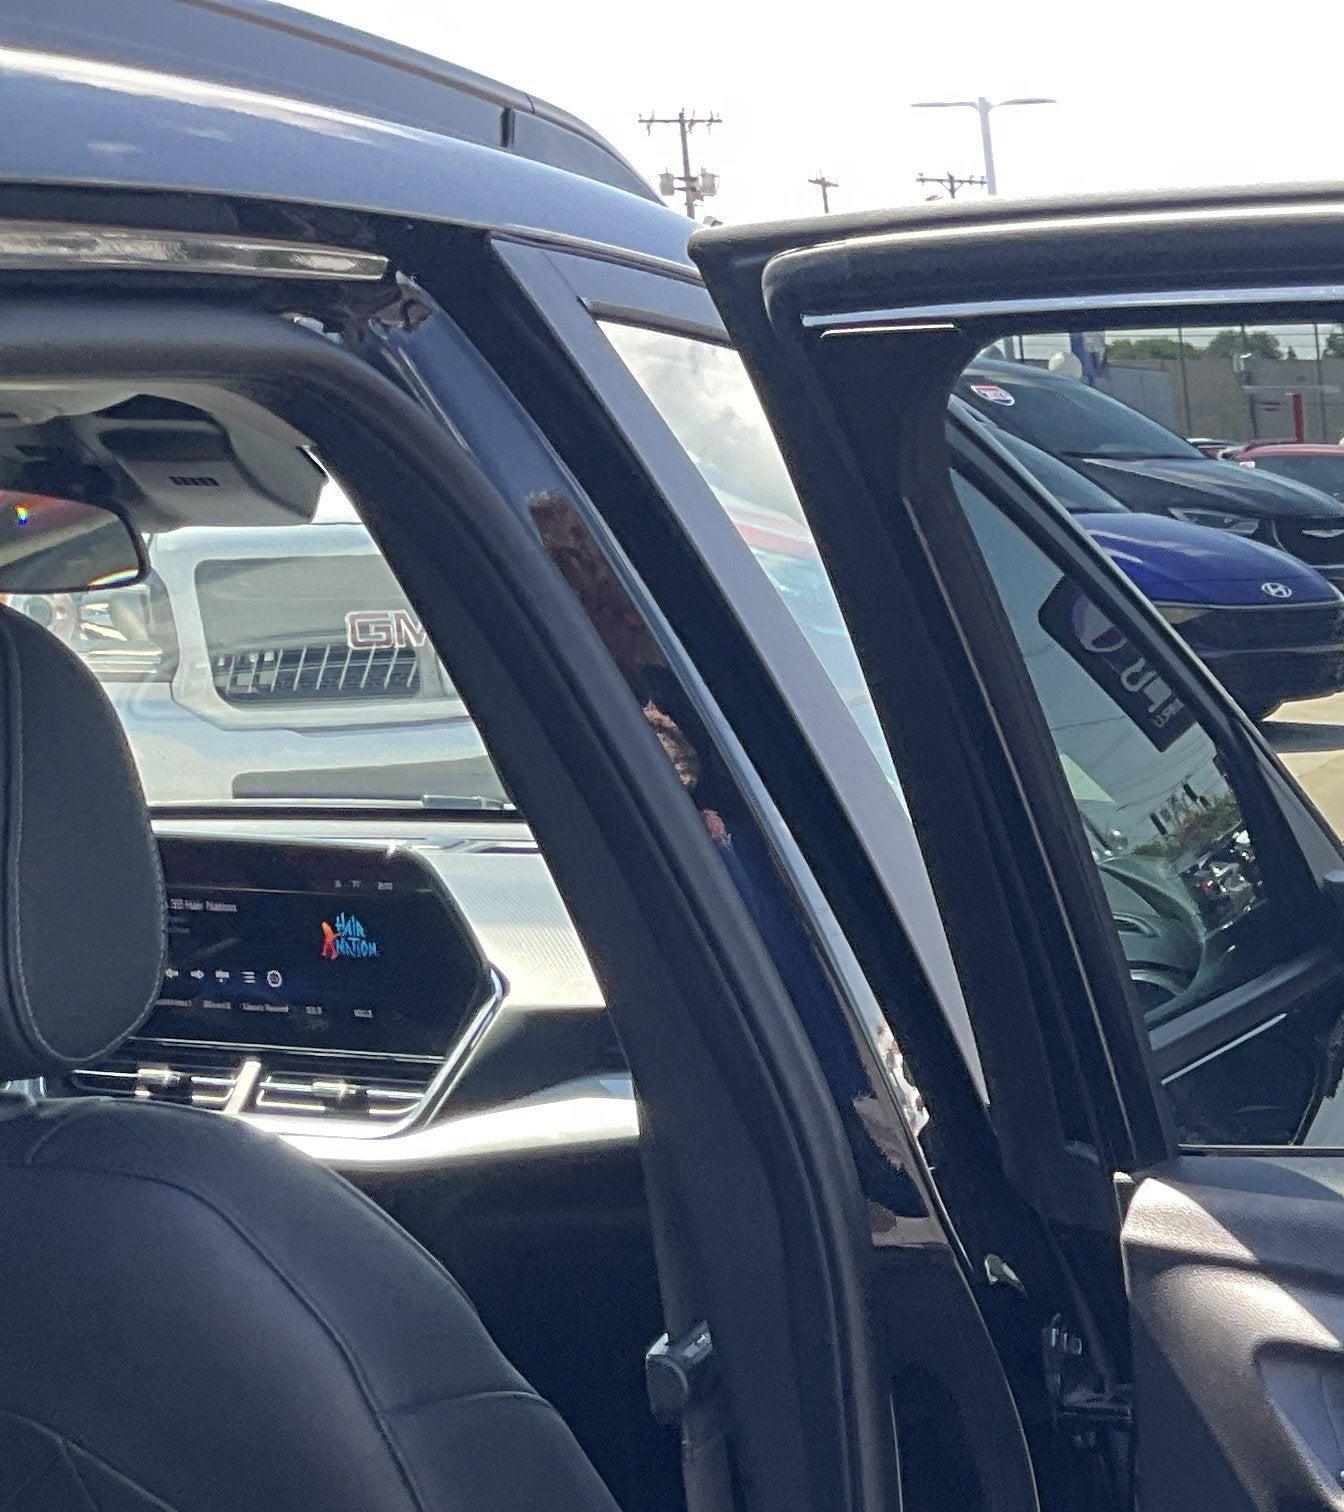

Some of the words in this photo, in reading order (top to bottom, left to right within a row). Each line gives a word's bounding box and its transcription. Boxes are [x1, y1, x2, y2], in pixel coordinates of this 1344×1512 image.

[345, 609, 427, 649] GM
[335, 911, 366, 938] HAIR
[335, 937, 378, 957] NATION
